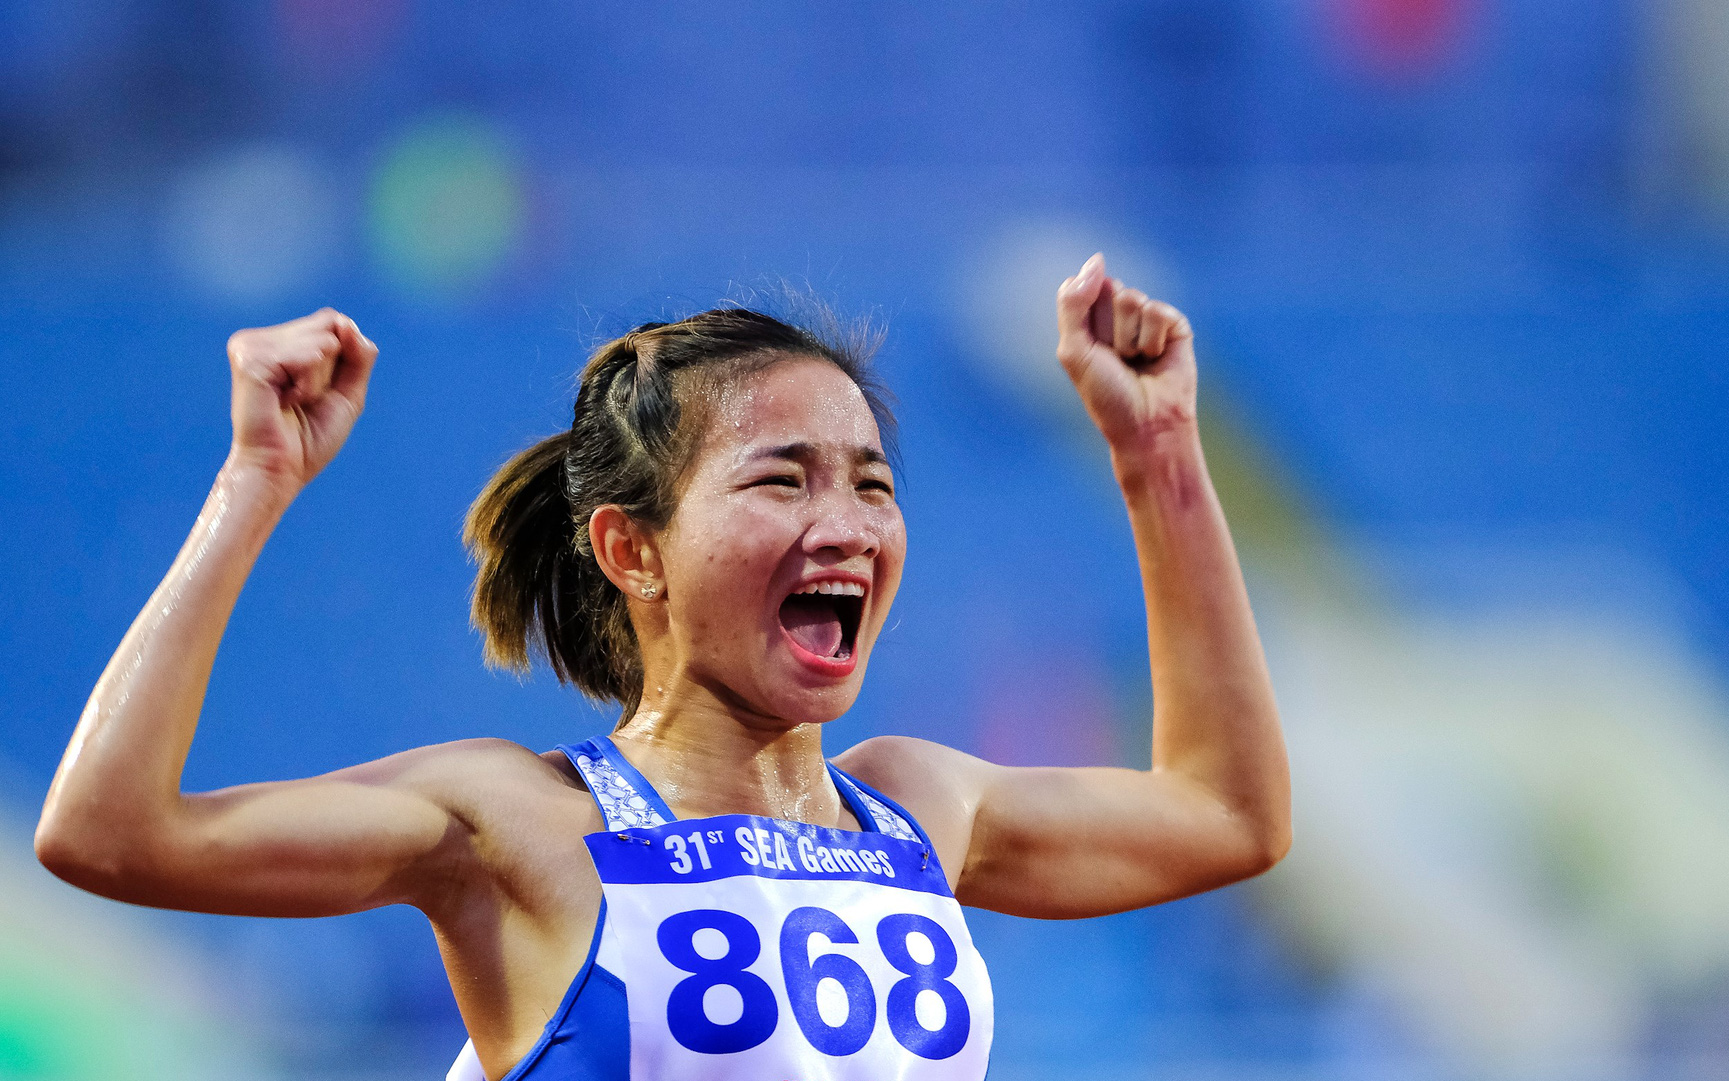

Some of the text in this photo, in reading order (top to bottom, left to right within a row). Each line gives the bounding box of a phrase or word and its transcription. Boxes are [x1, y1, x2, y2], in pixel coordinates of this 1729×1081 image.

[664, 826, 896, 879] 31ST SEA Games
[656, 906, 971, 1061] 868
